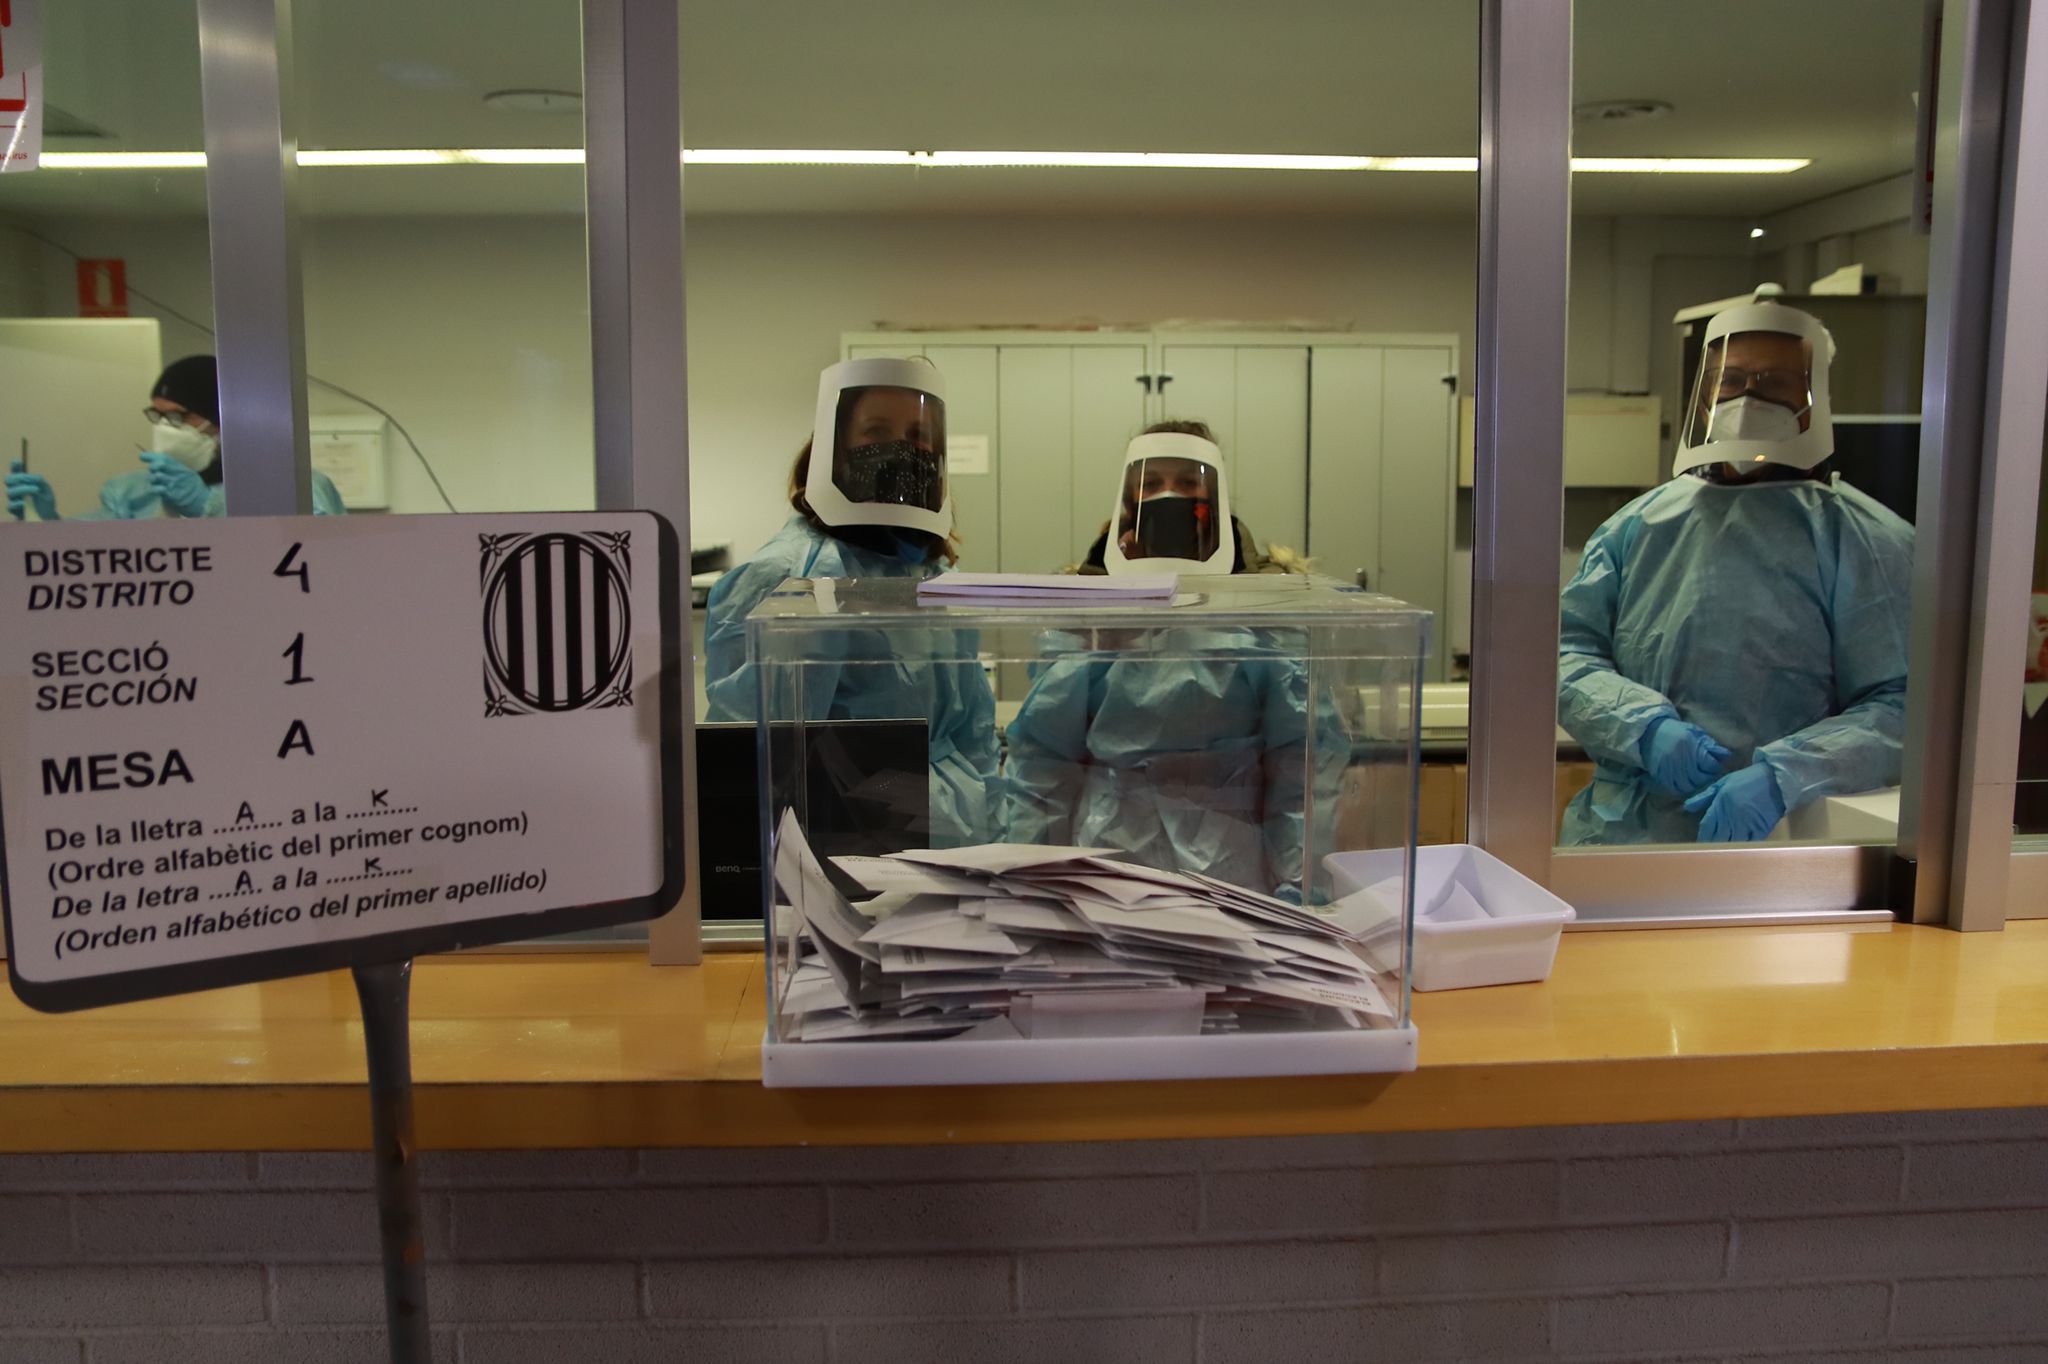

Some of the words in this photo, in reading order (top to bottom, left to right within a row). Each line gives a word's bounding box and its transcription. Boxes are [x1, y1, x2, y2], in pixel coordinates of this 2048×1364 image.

[25, 547, 212, 576] DISTRICTE
[273, 542, 310, 593] 4
[28, 580, 194, 610] DISTRITO
[31, 641, 168, 678] SECCIÓ
[281, 632, 314, 685] 1
[36, 673, 197, 711] SECCIÓN
[277, 719, 314, 759] A
[42, 749, 194, 795] MESA
[46, 828, 89, 851] De
[96, 824, 121, 846] la
[131, 817, 202, 842] lletra
[292, 809, 306, 825] a
[315, 802, 336, 822] la
[48, 857, 144, 890] (Ordre
[155, 841, 273, 873] alfabètic
[282, 834, 320, 858] del
[330, 825, 413, 857] primer
[421, 811, 528, 843] cognom)
[52, 896, 92, 919] De
[102, 891, 126, 913] la
[137, 886, 199, 908] letra
[272, 875, 286, 891] a
[296, 867, 317, 888] la
[55, 925, 157, 959] (Orden
[167, 904, 301, 939] alfabético
[310, 894, 349, 918] del
[356, 887, 440, 917] primer
[445, 869, 546, 903] apellido)
